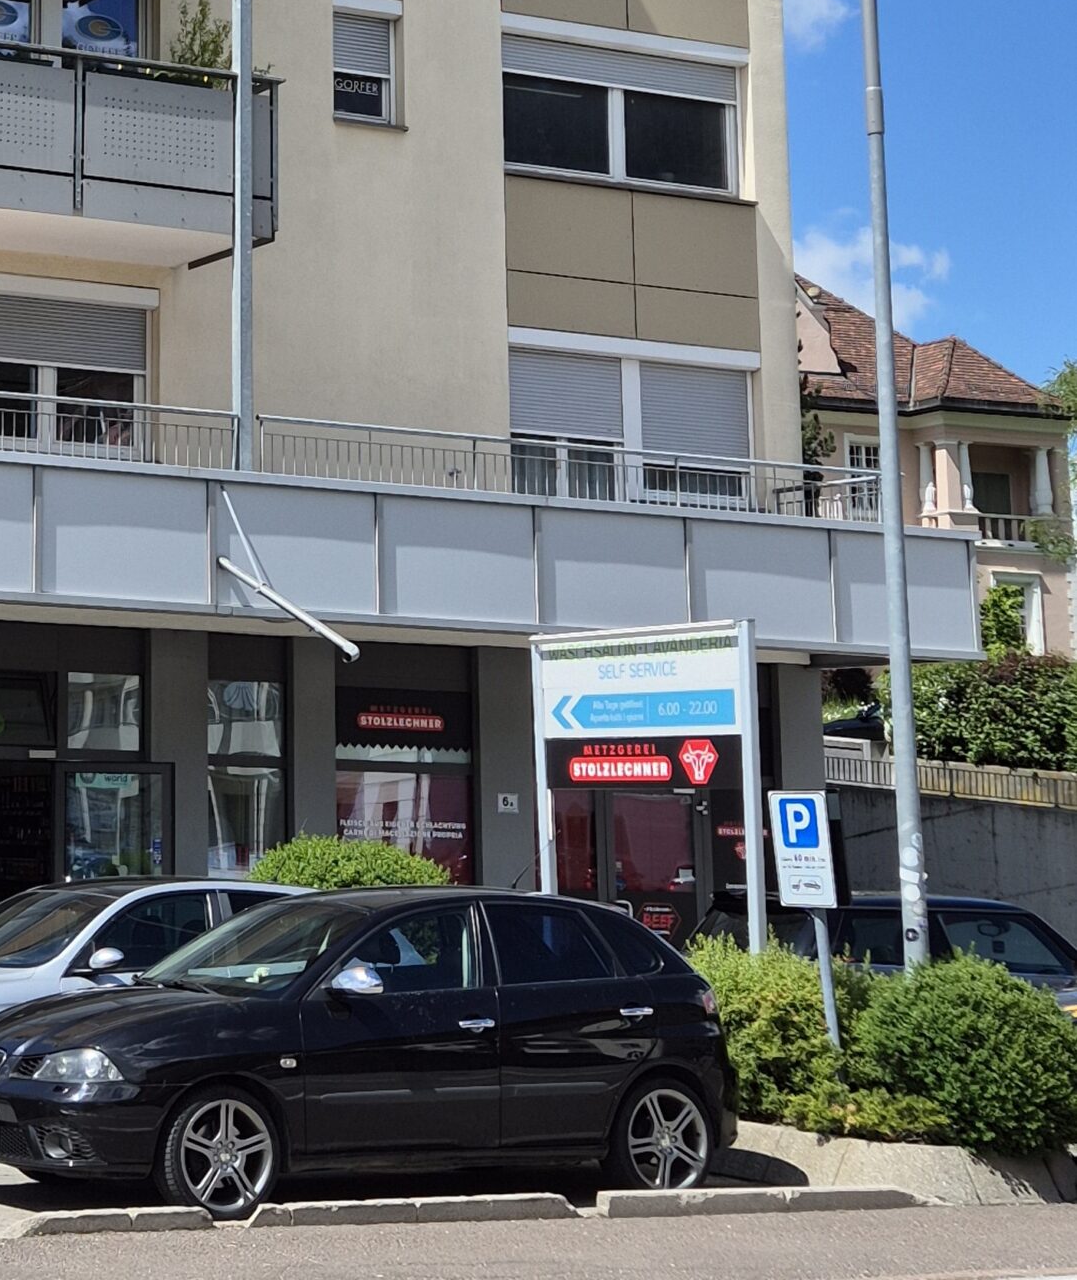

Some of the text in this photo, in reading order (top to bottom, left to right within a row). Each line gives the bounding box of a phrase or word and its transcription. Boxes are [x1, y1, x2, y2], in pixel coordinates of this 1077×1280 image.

[334, 78, 379, 95] GORFER
[598, 660, 678, 680] SELF SERVICE
[658, 702, 680, 717] 6.00
[689, 700, 718, 716] 22.00
[360, 715, 442, 729] STOLZLECHNER
[583, 743, 656, 756] METZGEREI
[573, 760, 669, 777] STOLZLECHNER
[785, 803, 811, 843] P
